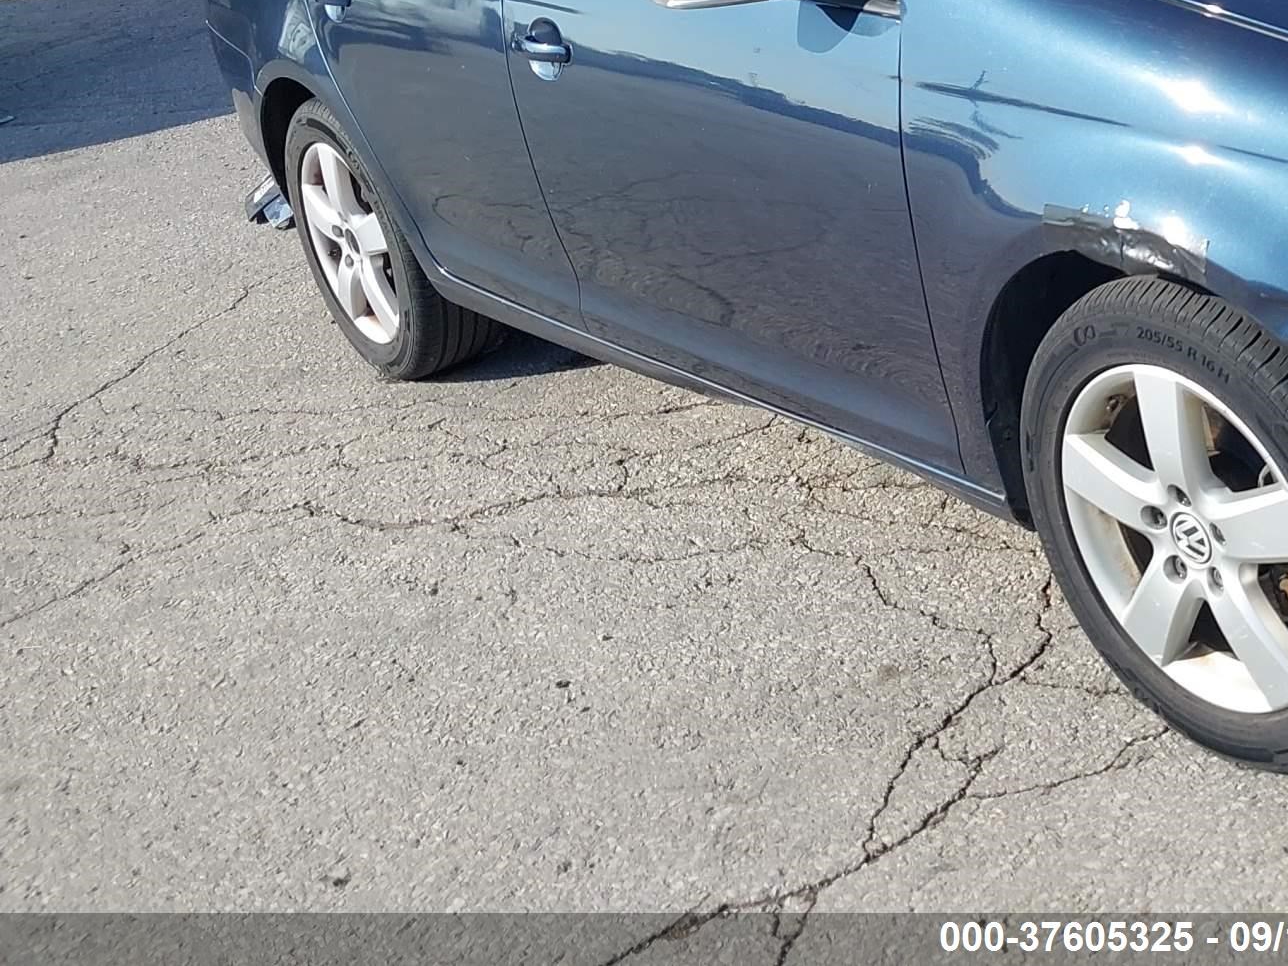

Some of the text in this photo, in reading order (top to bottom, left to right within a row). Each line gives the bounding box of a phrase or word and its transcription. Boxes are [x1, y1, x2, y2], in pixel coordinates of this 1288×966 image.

[1136, 326, 1183, 352] 205/55
[1187, 346, 1198, 361] R
[1201, 355, 1216, 373] 16
